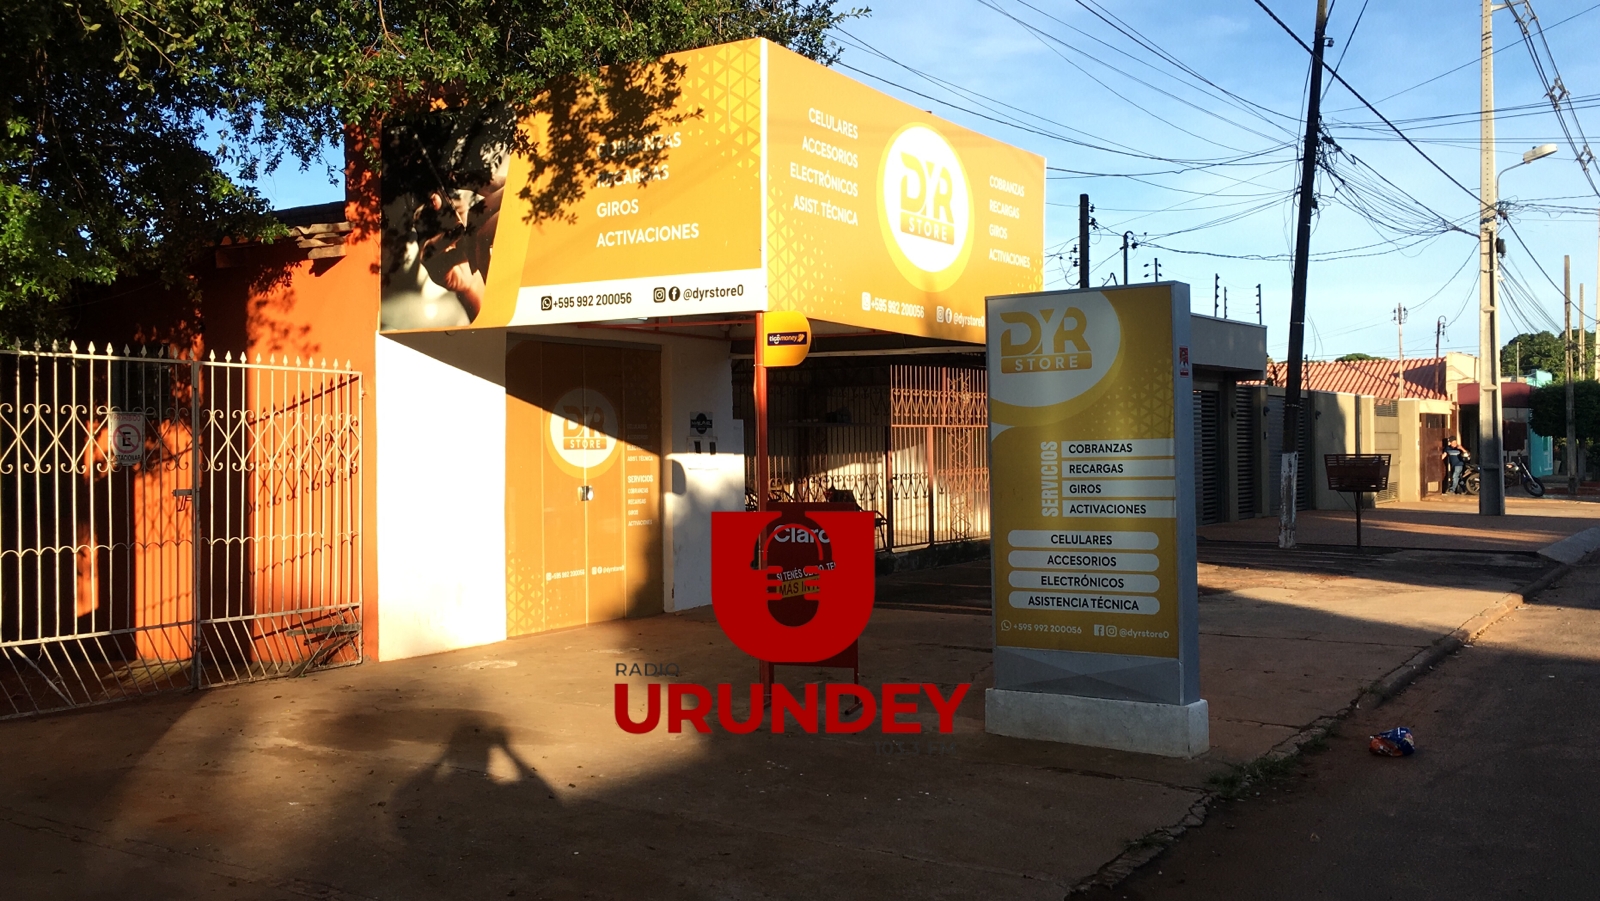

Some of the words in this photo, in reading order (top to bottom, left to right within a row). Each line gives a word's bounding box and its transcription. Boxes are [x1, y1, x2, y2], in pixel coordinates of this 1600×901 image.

[808, 107, 858, 139] CELULARES
[596, 131, 682, 159] COBRANZAS
[802, 136, 858, 168] ACCESORIOS
[596, 164, 670, 189] RECARGAS
[790, 161, 858, 197] ELECTRÓNICOS
[989, 175, 1025, 197] COBRANZAS
[596, 199, 639, 218] GIROS
[793, 194, 820, 216] ASIST.
[821, 199, 858, 226] TÉCNICA
[989, 199, 1020, 219] RECARGAS
[596, 222, 700, 248] ACTIVACIONES
[908, 216, 948, 241] STORE
[989, 224, 1008, 240] GIROS
[988, 248, 1031, 269] ACTIVACIONES
[553, 296, 575, 309] +595
[576, 294, 594, 307] 992
[596, 292, 632, 306] 200056
[683, 284, 744, 303] @dyrstore0
[871, 297, 887, 313] +595
[888, 299, 900, 315] 992
[901, 302, 925, 319] 200056
[1015, 355, 1079, 371] STORE
[570, 439, 601, 449] STORE
[1068, 443, 1133, 454] COBRANZAS
[1069, 463, 1124, 474] RECARGAS
[627, 475, 654, 483] SERVICIOS
[1040, 441, 1059, 517] SERVICIOS
[1069, 484, 1102, 494] GIROS
[1069, 504, 1147, 514] ACTIVACIONES
[1050, 534, 1113, 545] CELULARES
[1047, 554, 1117, 567] ACCESORIOS
[783, 567, 803, 581] TENÉS
[1041, 574, 1125, 588] ELECTRÓNICOS
[779, 580, 799, 596] MÁS
[1028, 595, 1089, 609] ASISTENCIA
[1090, 596, 1139, 611] TÉCNICA
[1013, 622, 1032, 632] +595
[1034, 623, 1048, 632] 992
[1050, 624, 1082, 634] 200056
[1119, 627, 1169, 639] @dyrstore0
